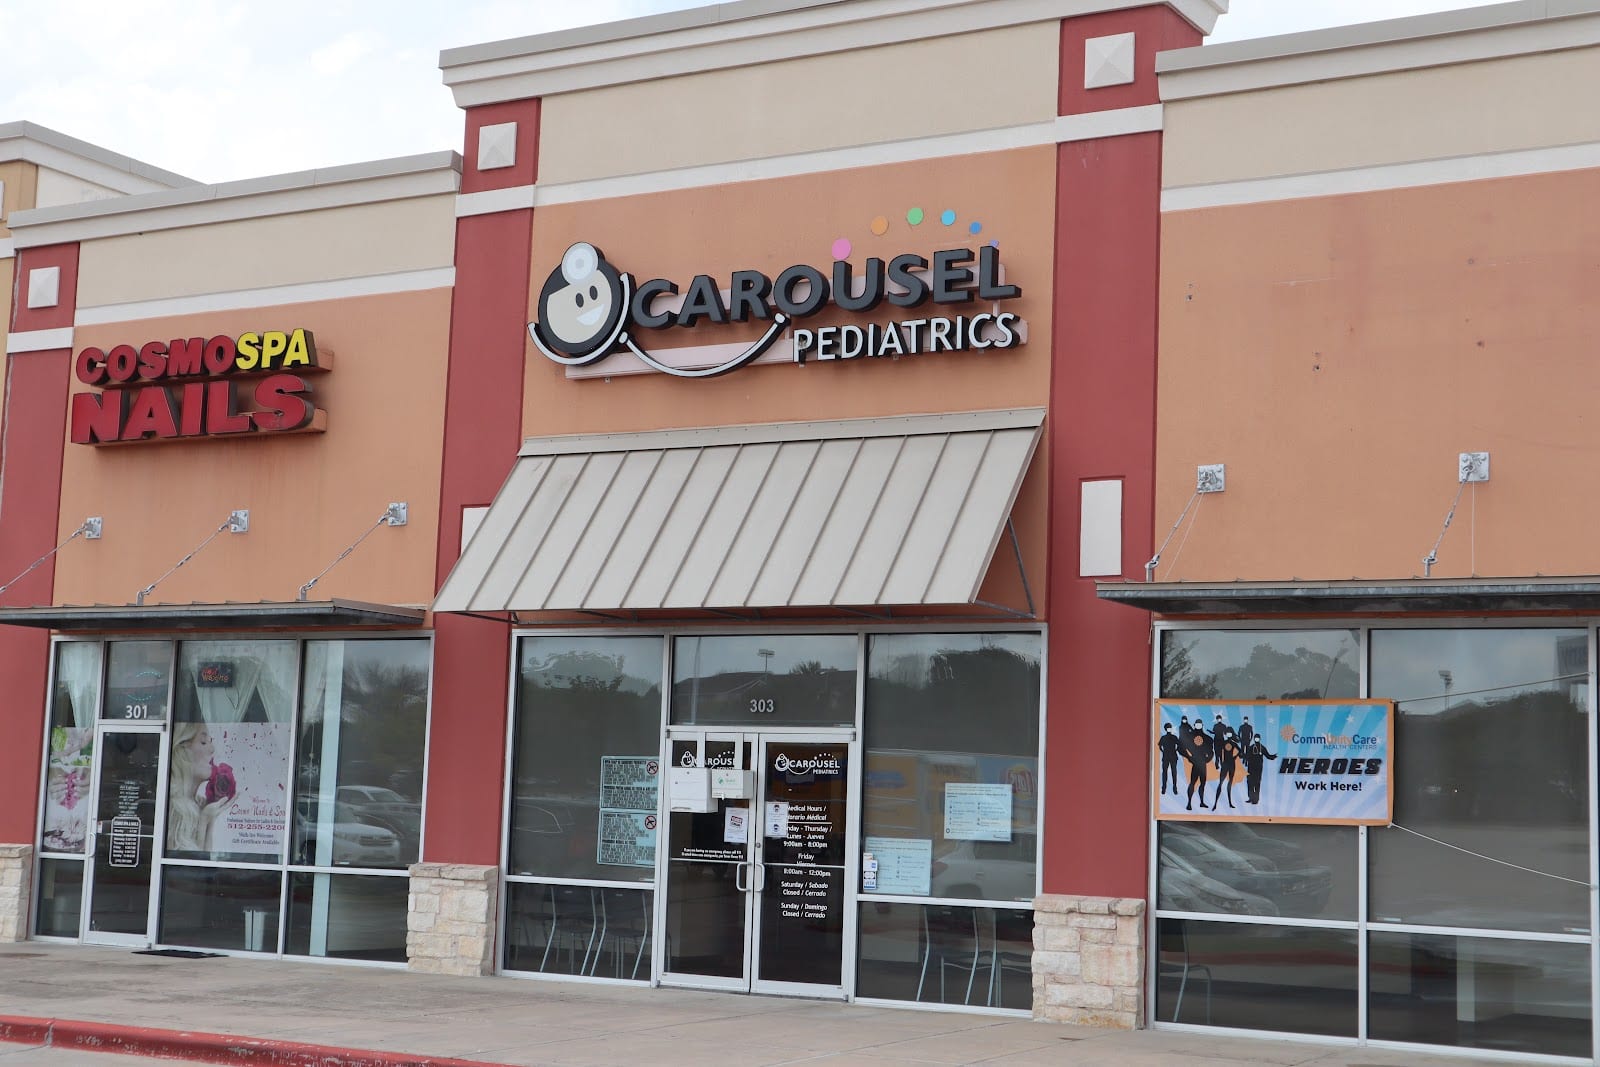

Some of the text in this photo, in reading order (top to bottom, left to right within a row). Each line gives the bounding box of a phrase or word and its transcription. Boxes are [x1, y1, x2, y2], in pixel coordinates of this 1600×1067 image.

[631, 245, 1021, 328] CAROUSEL
[792, 312, 1018, 363] PEDIATRICS
[71, 374, 312, 444] NAILS
[750, 699, 775, 713] 303
[125, 704, 148, 719] 301
[1291, 733, 1377, 746] CommUnityCare
[789, 759, 841, 768] CAROUSEL
[1279, 758, 1382, 775] HEROES
[1295, 781, 1363, 791] Work Here!
[804, 825, 829, 834] Thursday
[783, 840, 803, 848] 9:00am
[807, 841, 828, 849] 8:00pm
[797, 852, 815, 861] Friday
[808, 869, 831, 877] 12:00pm
[781, 880, 804, 889] Saturday
[782, 888, 800, 896] Closed
[780, 902, 800, 910] Sunday
[804, 903, 828, 911] Domingo
[804, 911, 826, 919] Cerrado
